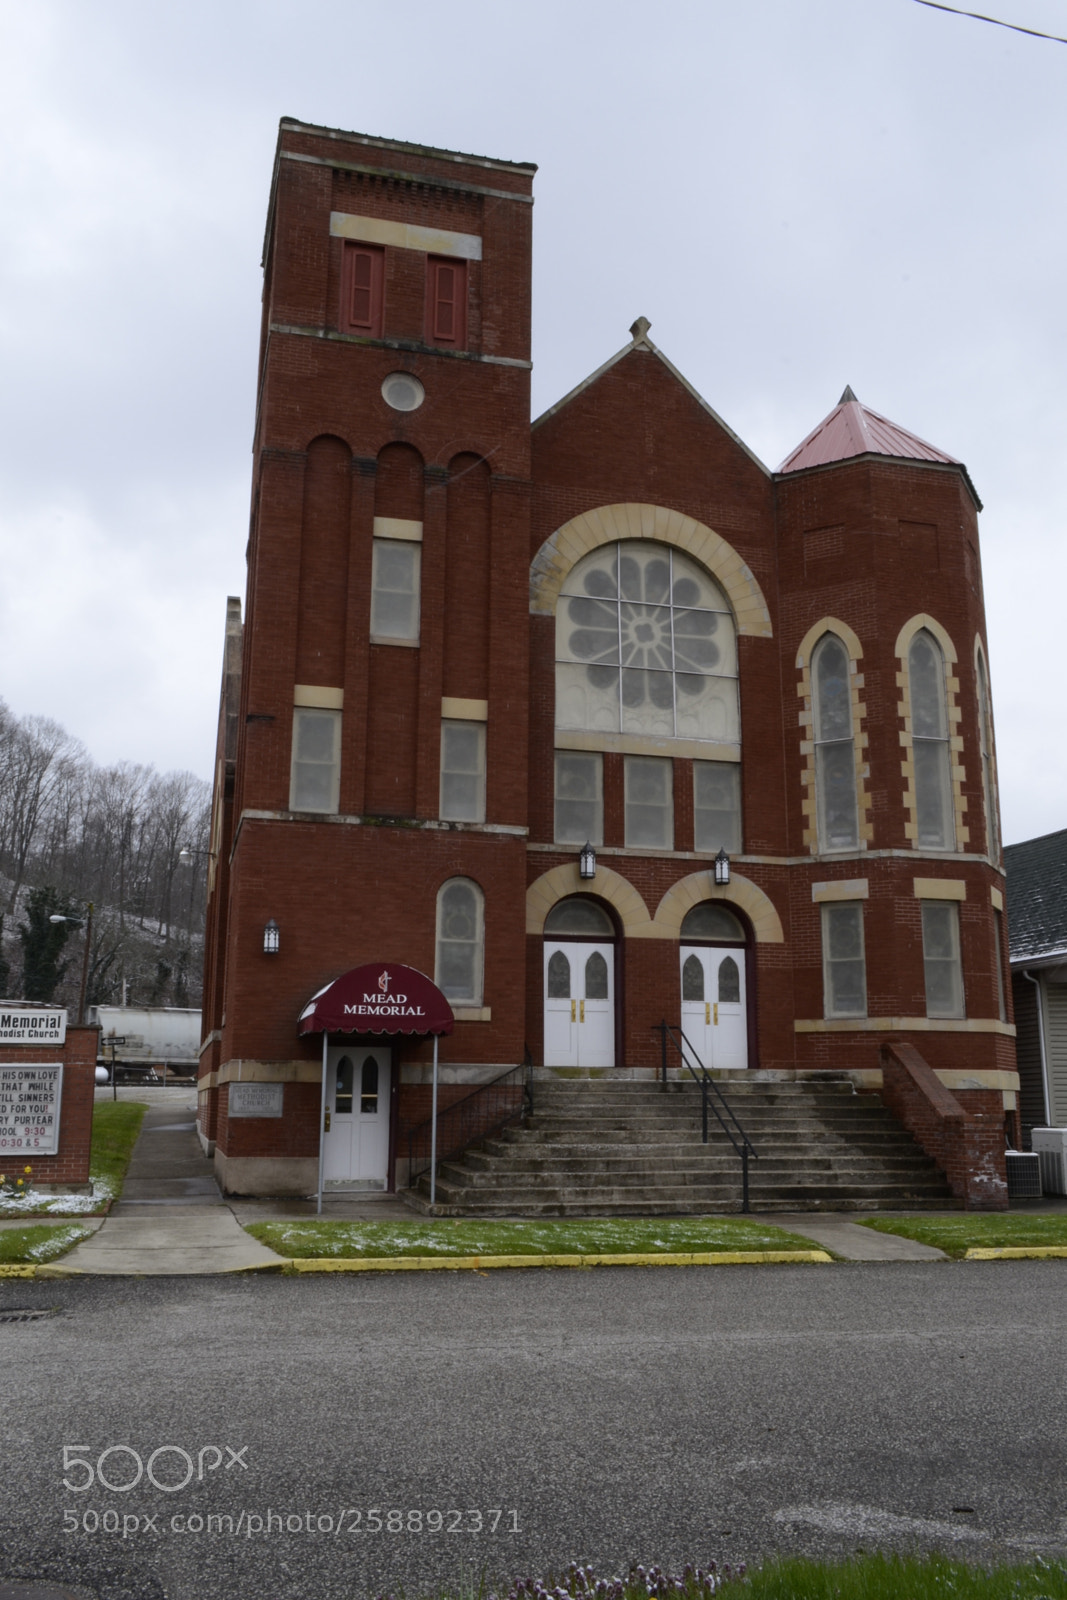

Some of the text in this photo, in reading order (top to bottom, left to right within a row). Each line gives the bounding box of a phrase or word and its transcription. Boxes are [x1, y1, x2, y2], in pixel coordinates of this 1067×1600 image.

[363, 993, 407, 1004] MEAD
[344, 1004, 425, 1016] MEMORIAL
[1, 1014, 61, 1029] Memorial
[28, 1029, 59, 1038] Church
[2, 1071, 58, 1080] HIS OWN LOVE
[1, 1082, 54, 1091] THAT WHILE
[0, 1093, 54, 1102] ILL SINNERS
[11, 1104, 27, 1113] FOR
[14, 1116, 53, 1125] PURYEAR
[24, 1127, 46, 1136] 9:30
[34, 1138, 40, 1147] 5
